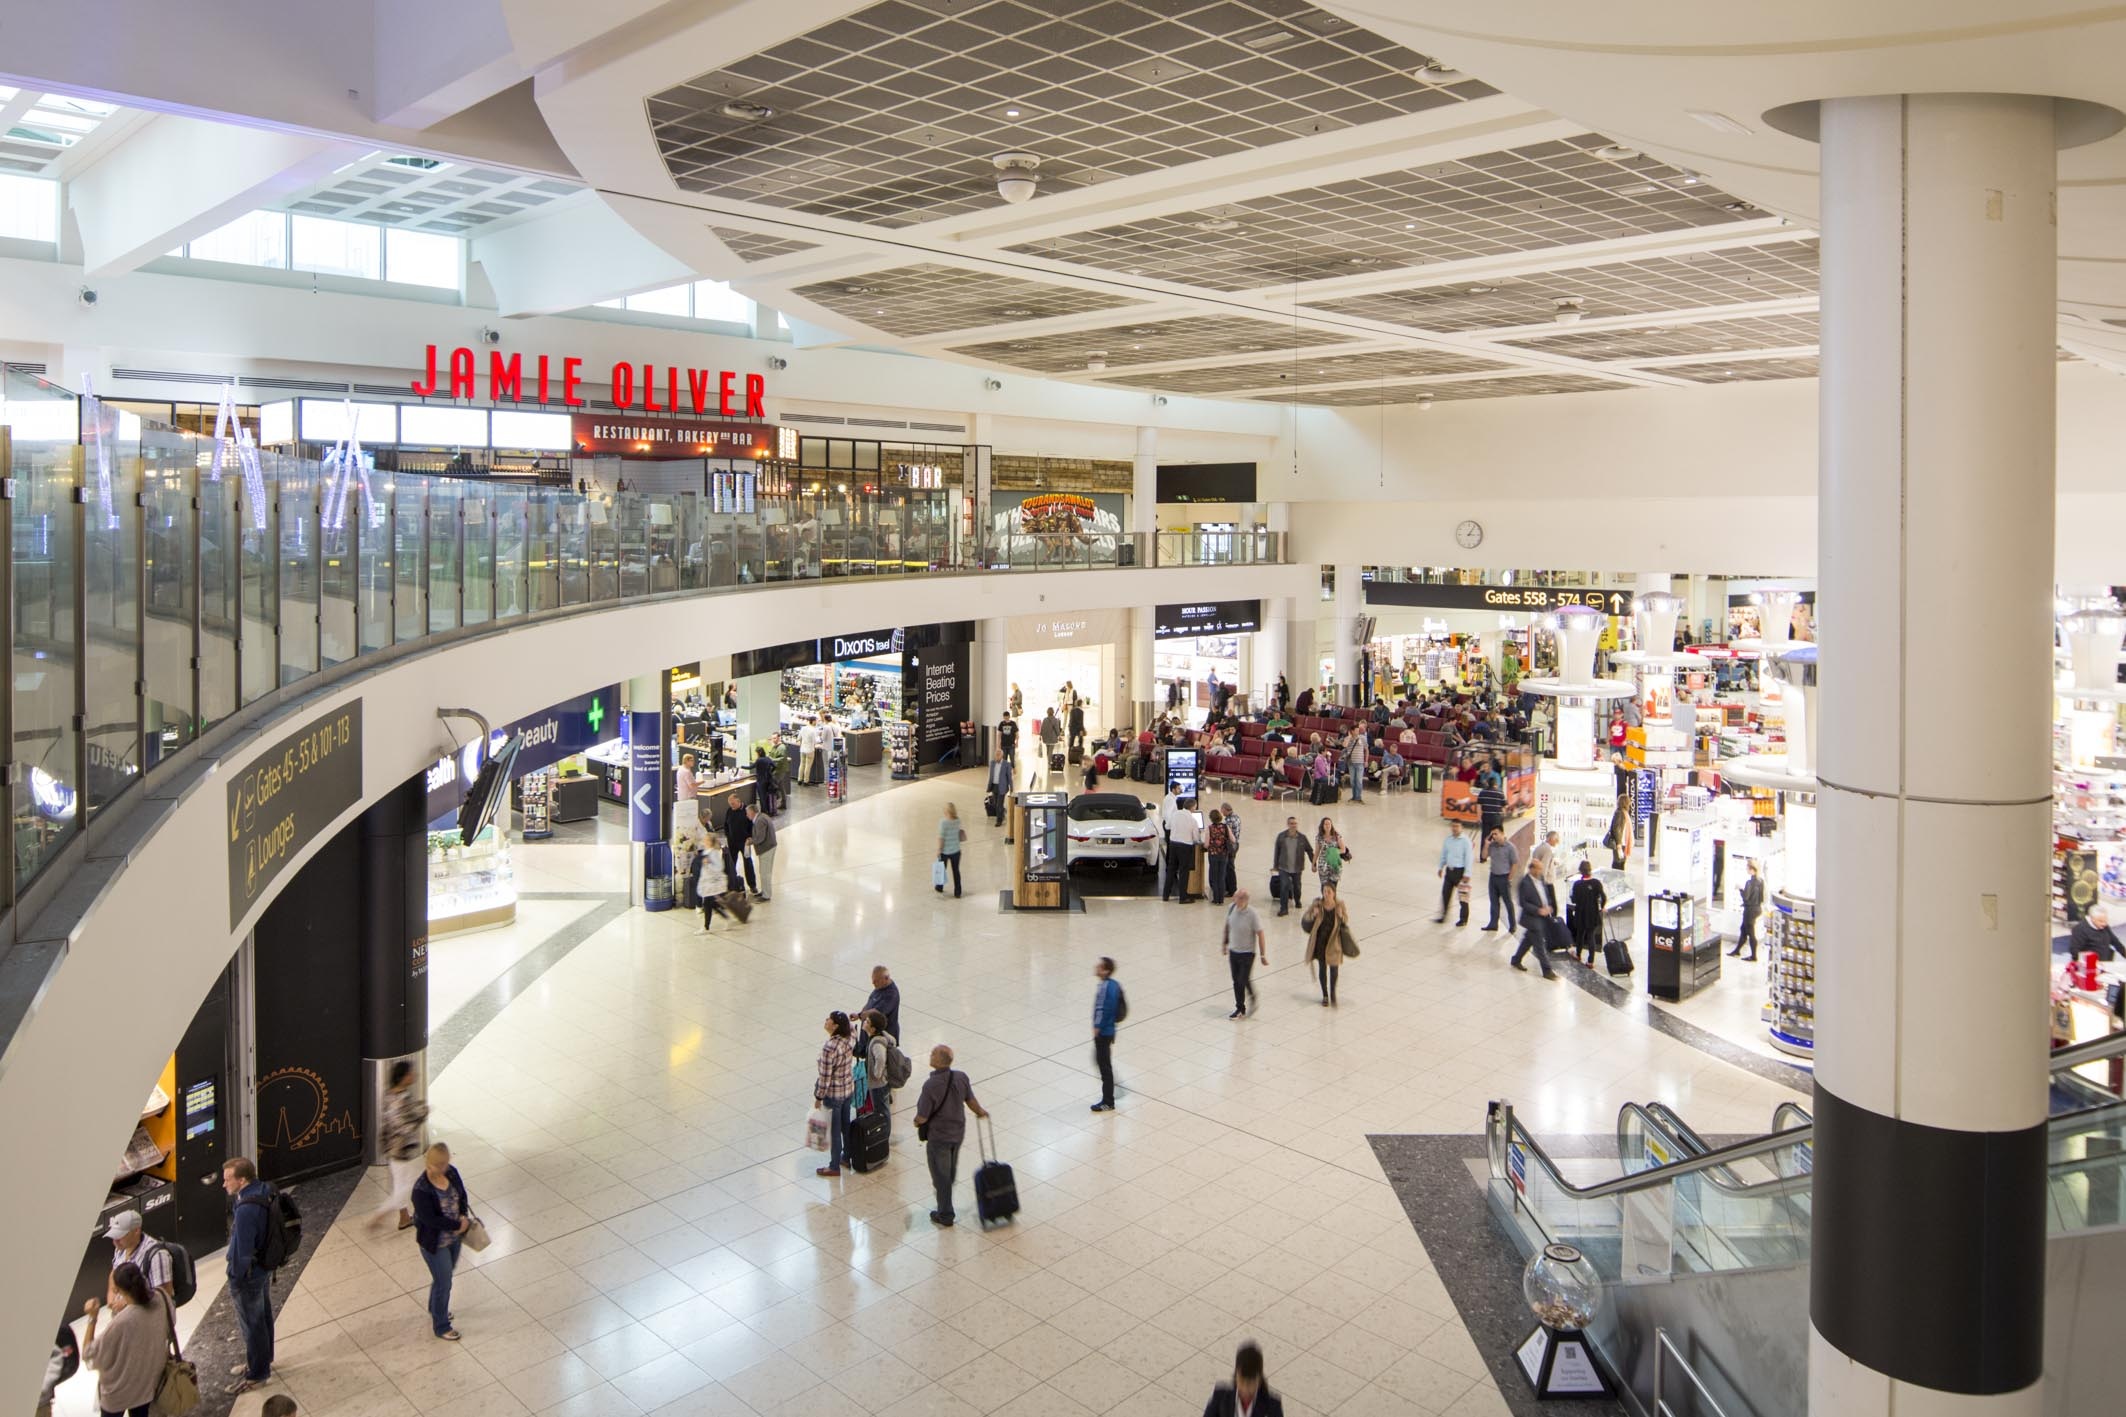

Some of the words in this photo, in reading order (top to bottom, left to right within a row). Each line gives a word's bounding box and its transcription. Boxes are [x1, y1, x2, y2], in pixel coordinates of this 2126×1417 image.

[411, 344, 583, 406] JAMIE
[612, 361, 765, 417] OLIVER
[594, 425, 673, 443] RESTAURANT,
[677, 429, 719, 444] BAKERY
[732, 433, 752, 446] BAR
[910, 465, 942, 489] BAR
[1485, 590, 1520, 605] Gates
[1523, 591, 1547, 606] 558
[1557, 593, 1580, 606] 574
[834, 638, 874, 657] Dixons
[876, 639, 890, 651] travel
[925, 662, 955, 677] Internet
[926, 676, 955, 691] Beating
[926, 690, 950, 704] Prices
[256, 762, 282, 806] Gates
[283, 748, 294, 784] 45
[299, 738, 310, 774] 55
[311, 732, 318, 765] &
[319, 723, 333, 758] 101
[337, 715, 350, 747] 113
[258, 812, 295, 871] Lounges
